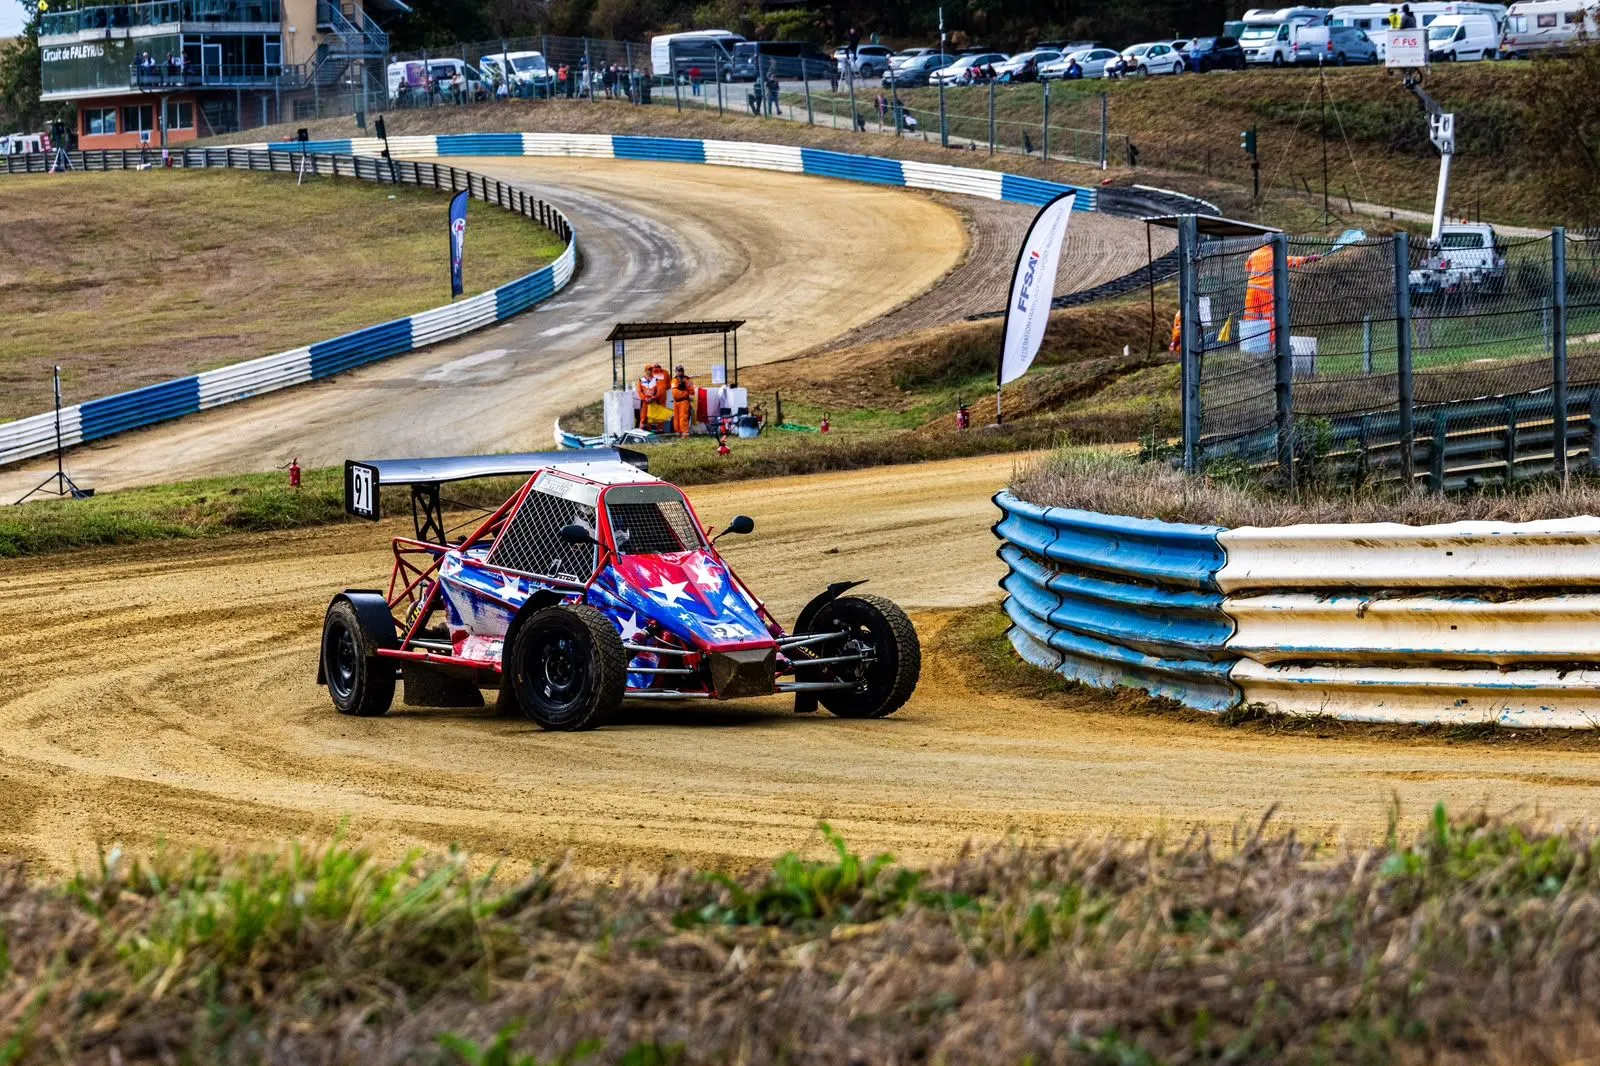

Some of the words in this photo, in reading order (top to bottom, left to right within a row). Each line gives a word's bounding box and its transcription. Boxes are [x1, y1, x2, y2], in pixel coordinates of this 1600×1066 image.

[43, 48, 62, 62] Circuit
[62, 48, 70, 60] de
[70, 44, 104, 59] FALEYRAS
[1017, 256, 1039, 313] FFSA
[355, 473, 369, 509] 91
